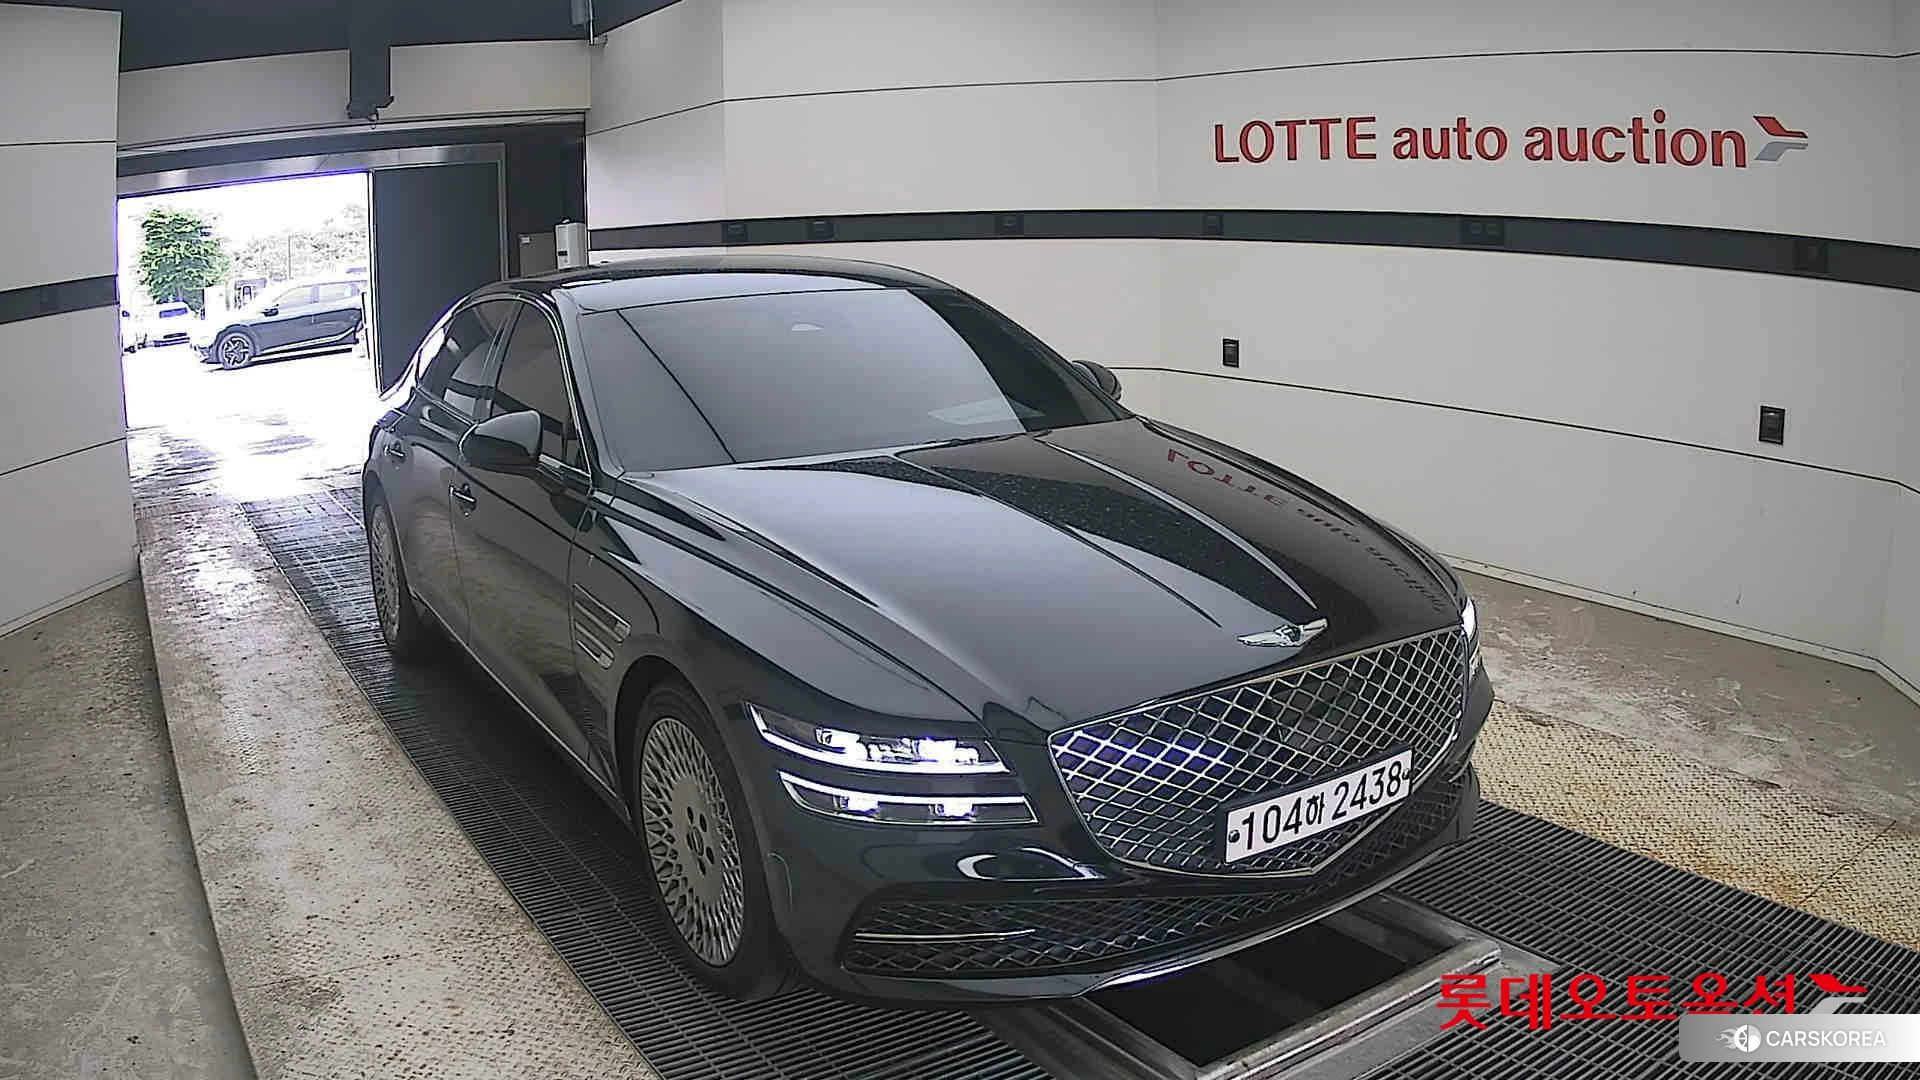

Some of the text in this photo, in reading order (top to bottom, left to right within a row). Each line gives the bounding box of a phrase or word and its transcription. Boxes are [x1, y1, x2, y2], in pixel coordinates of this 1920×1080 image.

[1214, 109, 1747, 168] LOTTE auto auction
[1241, 760, 1402, 850] 104하 2438
